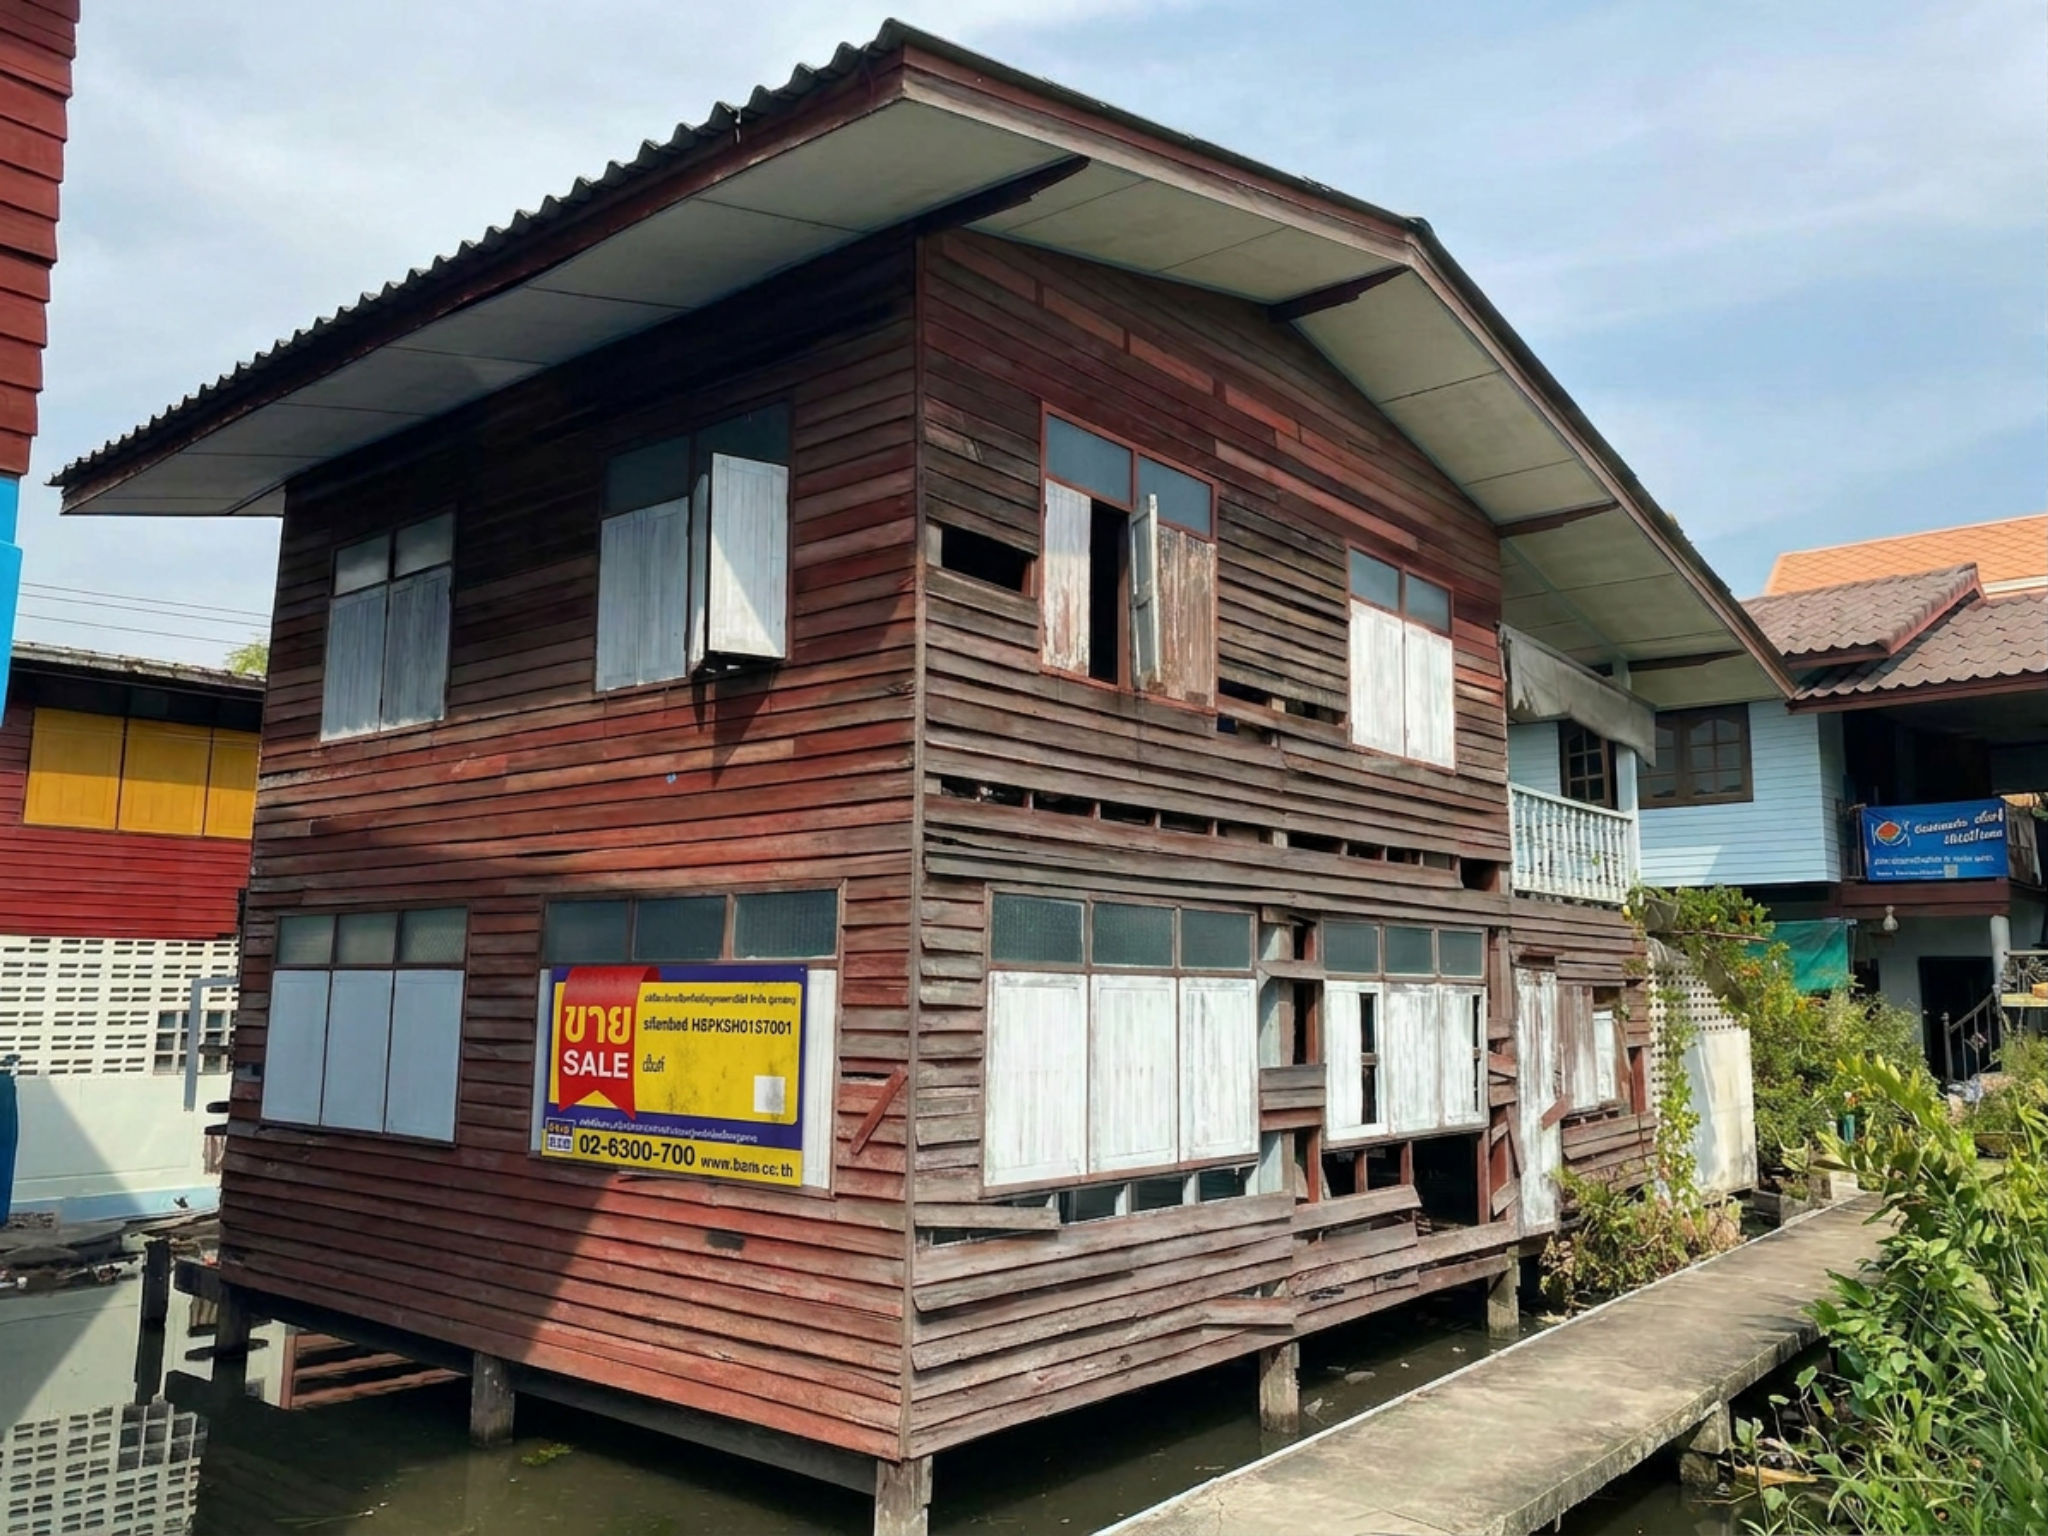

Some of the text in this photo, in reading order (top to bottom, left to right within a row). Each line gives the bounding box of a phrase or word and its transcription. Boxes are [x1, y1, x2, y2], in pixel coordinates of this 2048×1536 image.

[565, 1005, 632, 1045] ขาย
[562, 1049, 629, 1079] SALE
[578, 1134, 695, 1166] 02-6300-700
